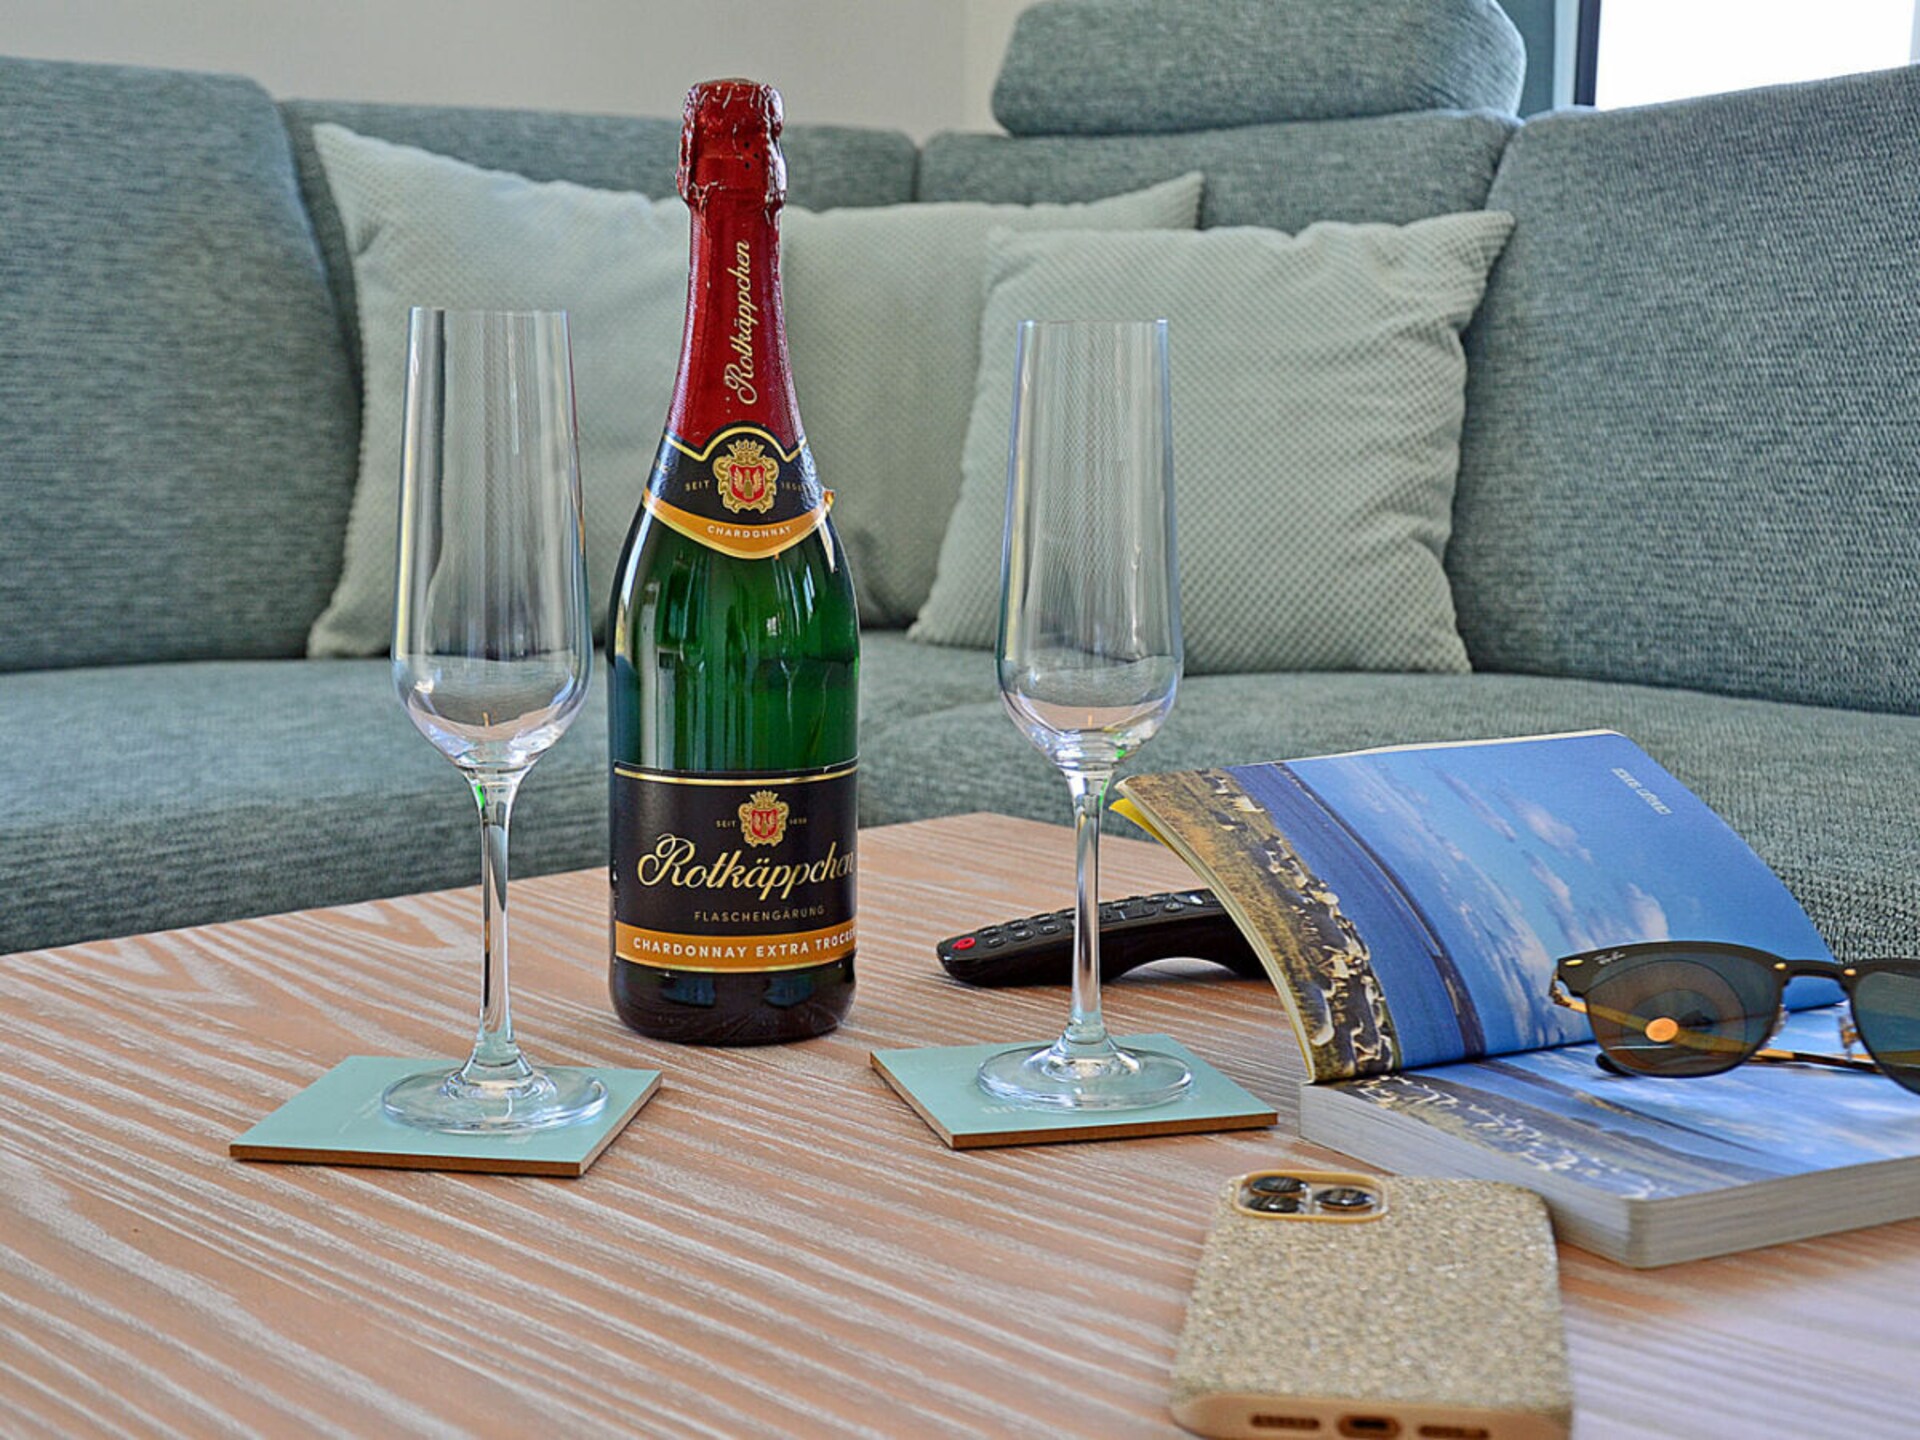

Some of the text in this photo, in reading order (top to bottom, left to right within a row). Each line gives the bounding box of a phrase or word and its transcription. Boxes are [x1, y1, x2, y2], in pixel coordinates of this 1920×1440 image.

[723, 240, 758, 405] Rotkäppchen
[684, 479, 710, 492] SEIT
[706, 525, 792, 538] CHARDONNAY
[716, 819, 736, 828] SEIT
[632, 936, 747, 958] CHARDONNAY
[755, 942, 809, 958] EXTRA
